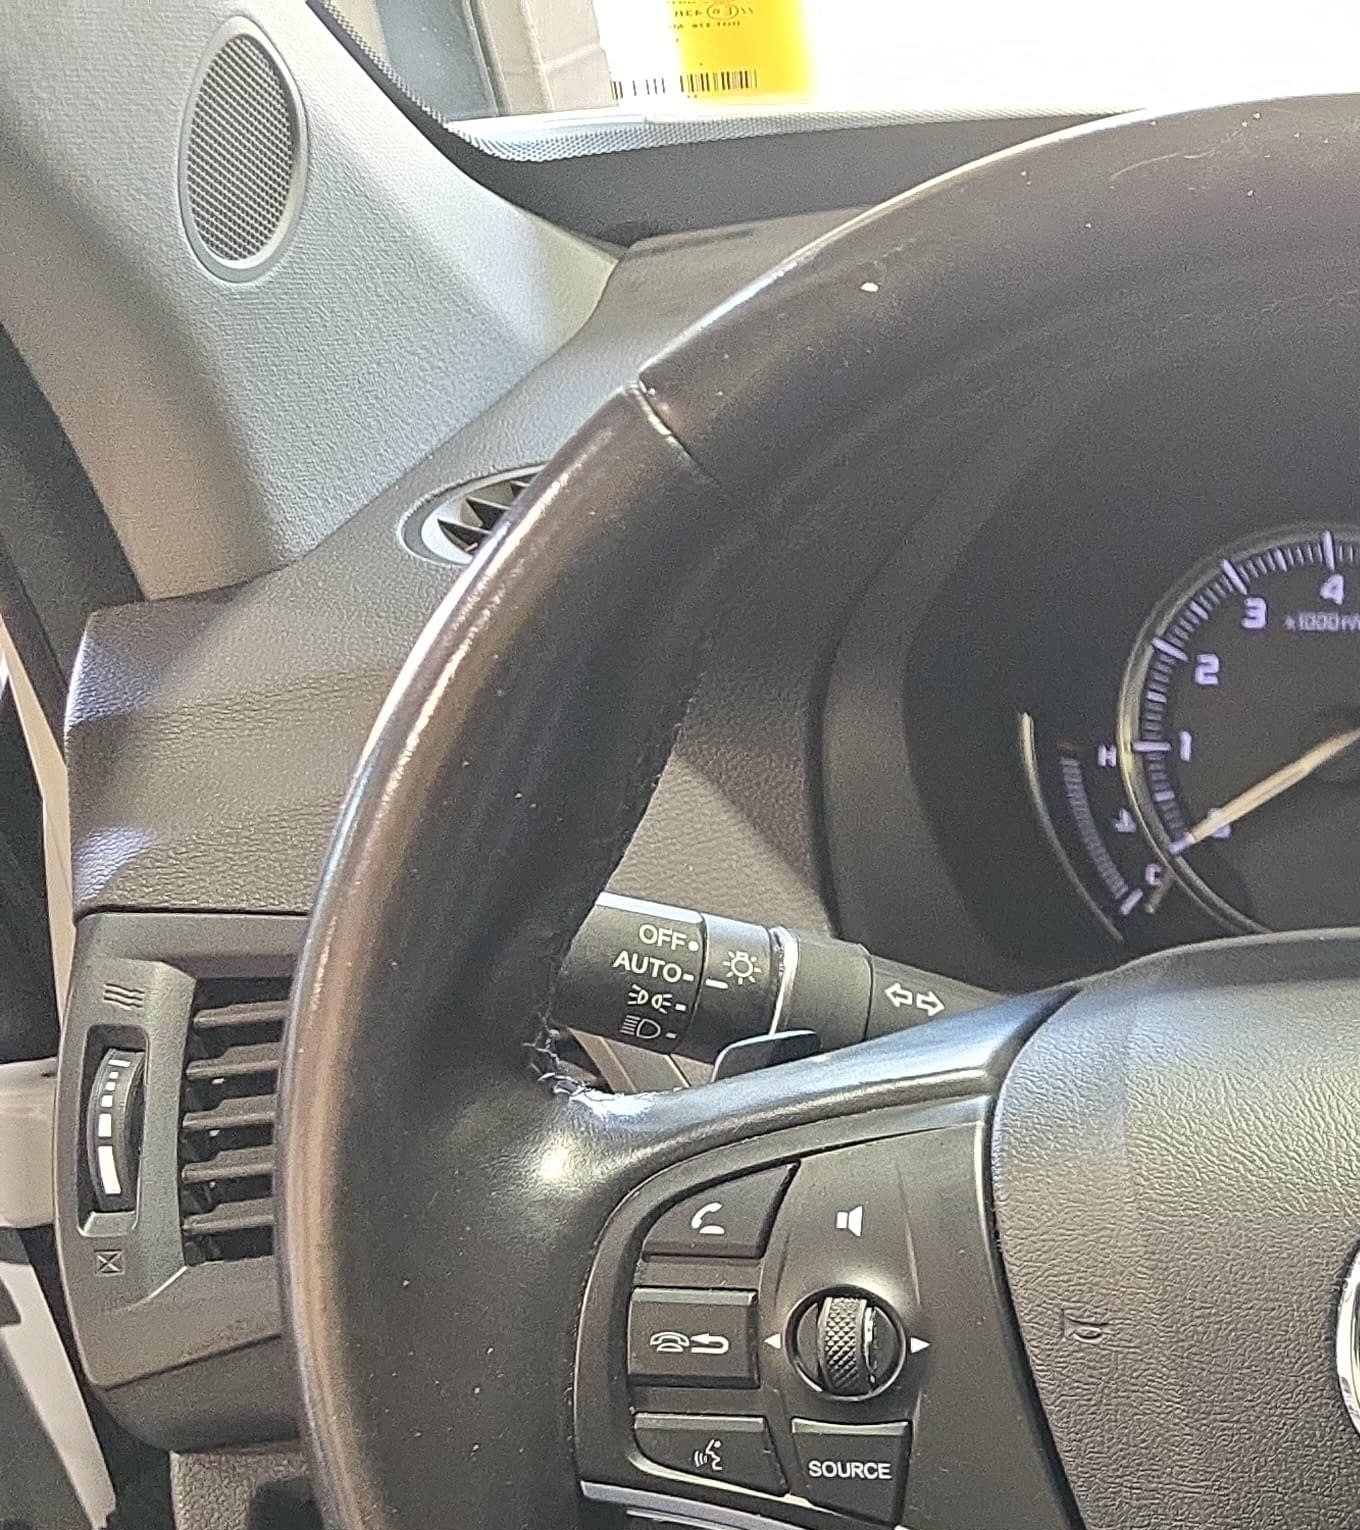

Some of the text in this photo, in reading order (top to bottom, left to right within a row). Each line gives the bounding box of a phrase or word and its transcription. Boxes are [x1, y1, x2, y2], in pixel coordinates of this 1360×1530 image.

[1321, 573, 1345, 605] 4
[1241, 597, 1267, 629] 3
[1194, 653, 1220, 685] 2
[1097, 744, 1117, 767] H
[1180, 731, 1192, 762] 1
[639, 924, 687, 950] OFF
[613, 949, 683, 984] AUTO
[808, 1460, 892, 1480] SOURCE
